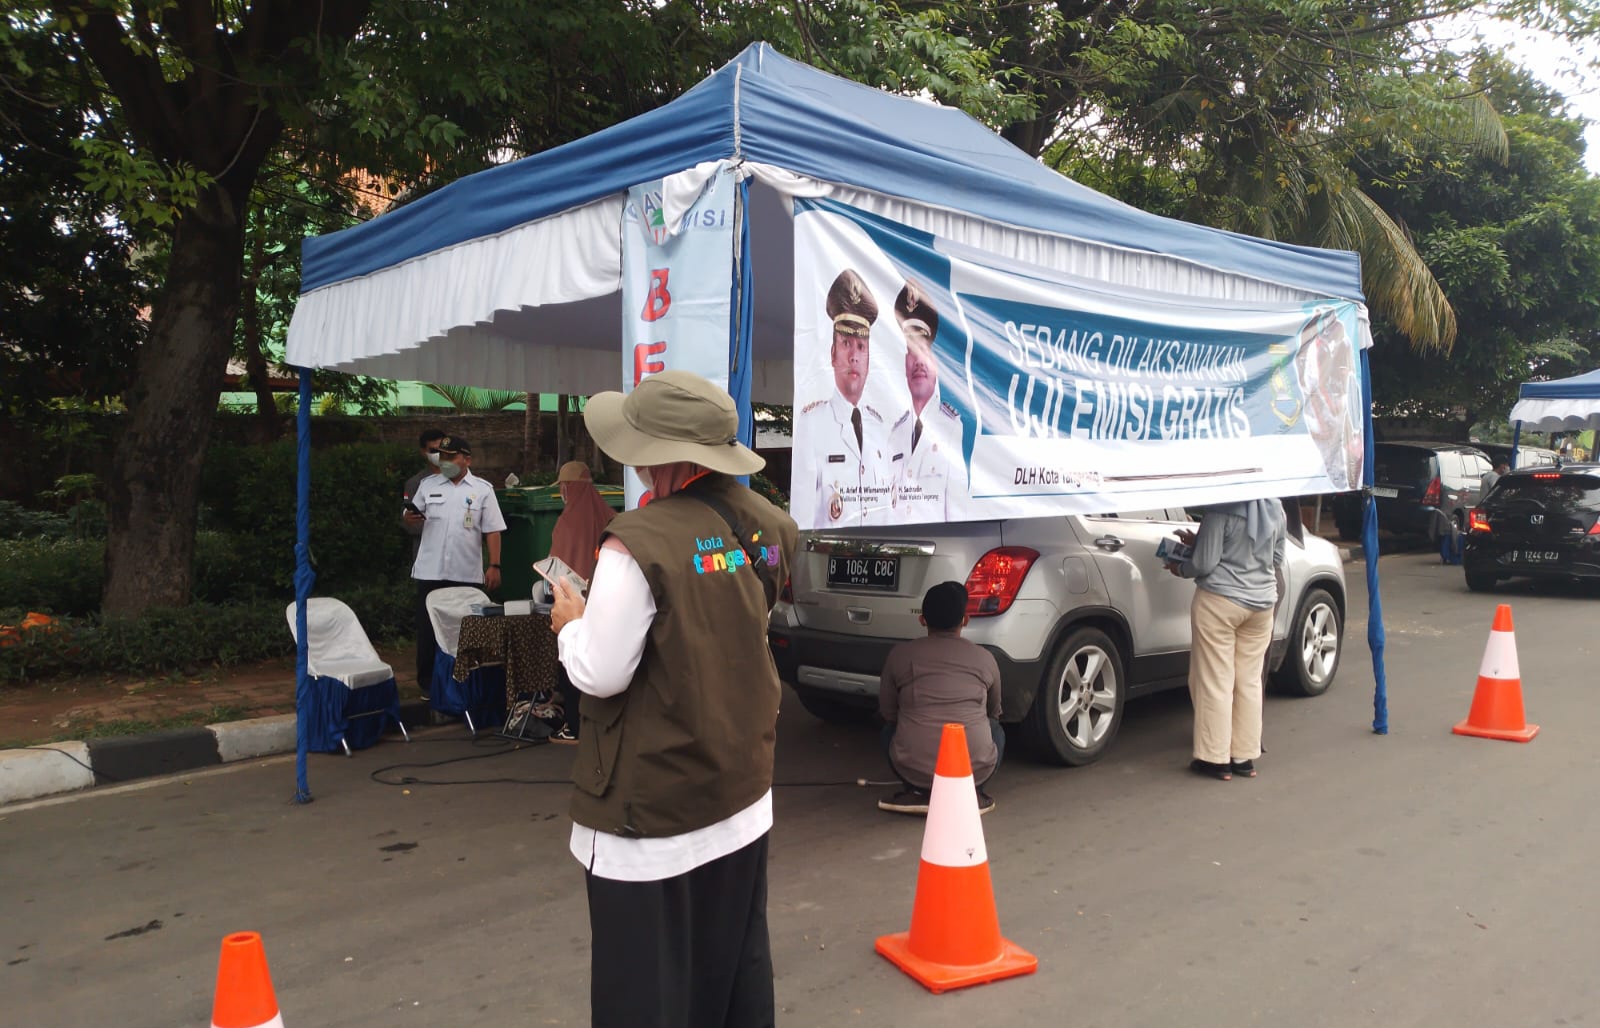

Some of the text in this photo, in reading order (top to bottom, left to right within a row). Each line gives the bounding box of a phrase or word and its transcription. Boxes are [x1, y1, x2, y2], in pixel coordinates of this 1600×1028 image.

[1005, 320, 1248, 382] SEDANG DILAKSANAKAN
[1008, 373, 1251, 441] UJI EMISI GRATIS
[1014, 467, 1037, 485] DLH
[1039, 467, 1060, 485] Kota
[695, 536, 724, 552] kota
[693, 544, 779, 575] tangerng
[830, 559, 837, 575] B
[846, 560, 869, 576] 1064
